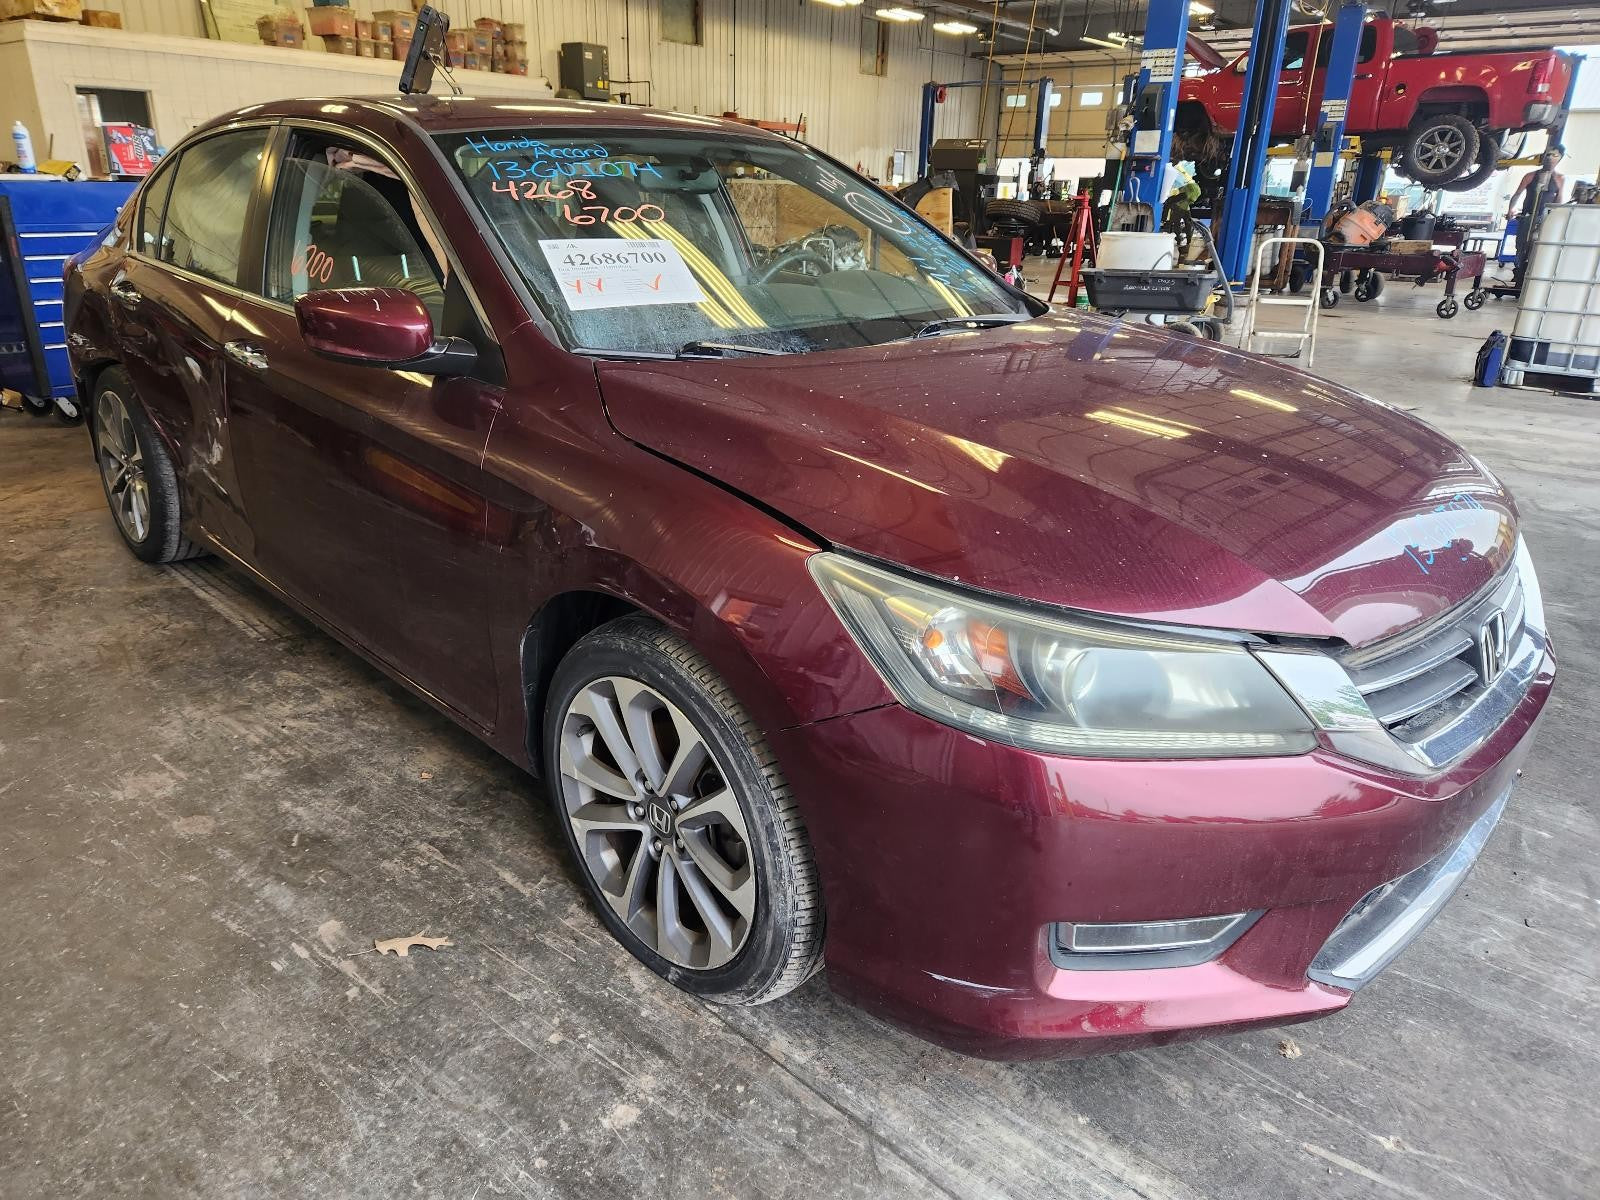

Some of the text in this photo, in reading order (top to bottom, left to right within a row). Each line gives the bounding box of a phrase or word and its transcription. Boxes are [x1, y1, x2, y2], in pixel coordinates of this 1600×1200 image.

[466, 136, 549, 154] Honda
[534, 144, 608, 158] Accord
[492, 180, 596, 200] 4268
[564, 204, 664, 225] 6700
[563, 252, 667, 267] 42686700
